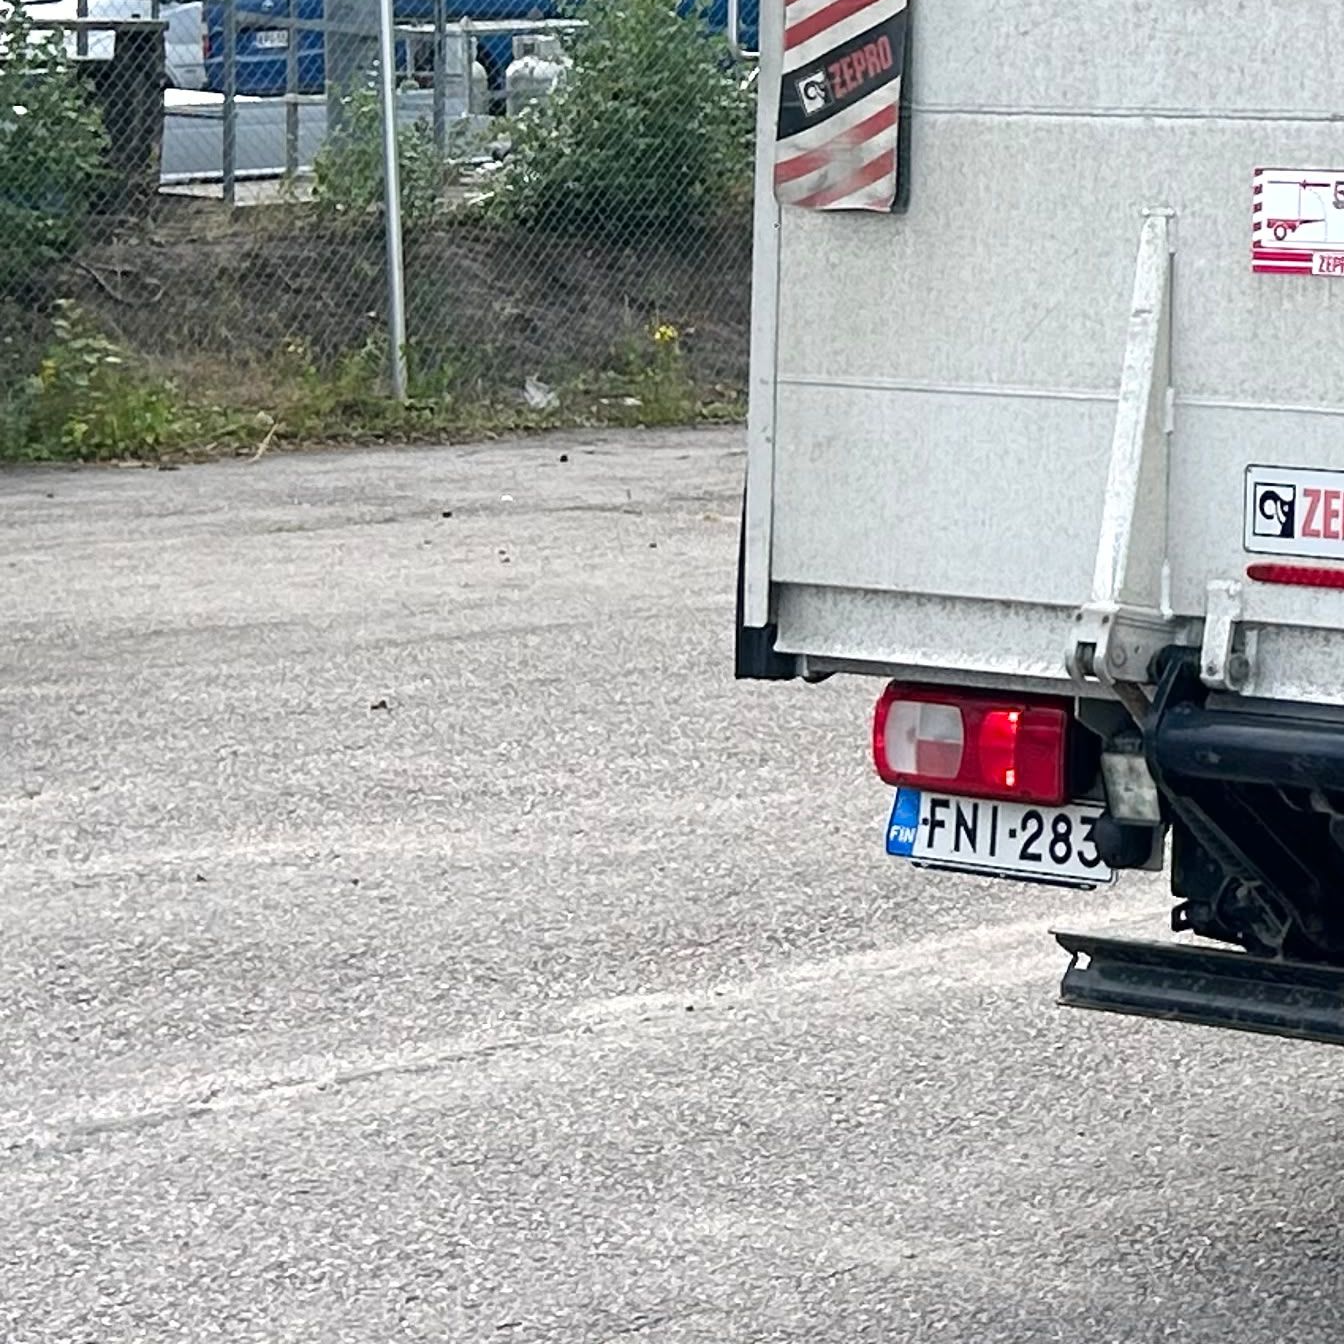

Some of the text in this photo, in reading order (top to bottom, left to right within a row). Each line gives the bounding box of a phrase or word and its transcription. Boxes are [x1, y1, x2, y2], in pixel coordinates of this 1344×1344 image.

[827, 35, 893, 99] ZEPRO
[889, 797, 1101, 868] FIN FNI-283
